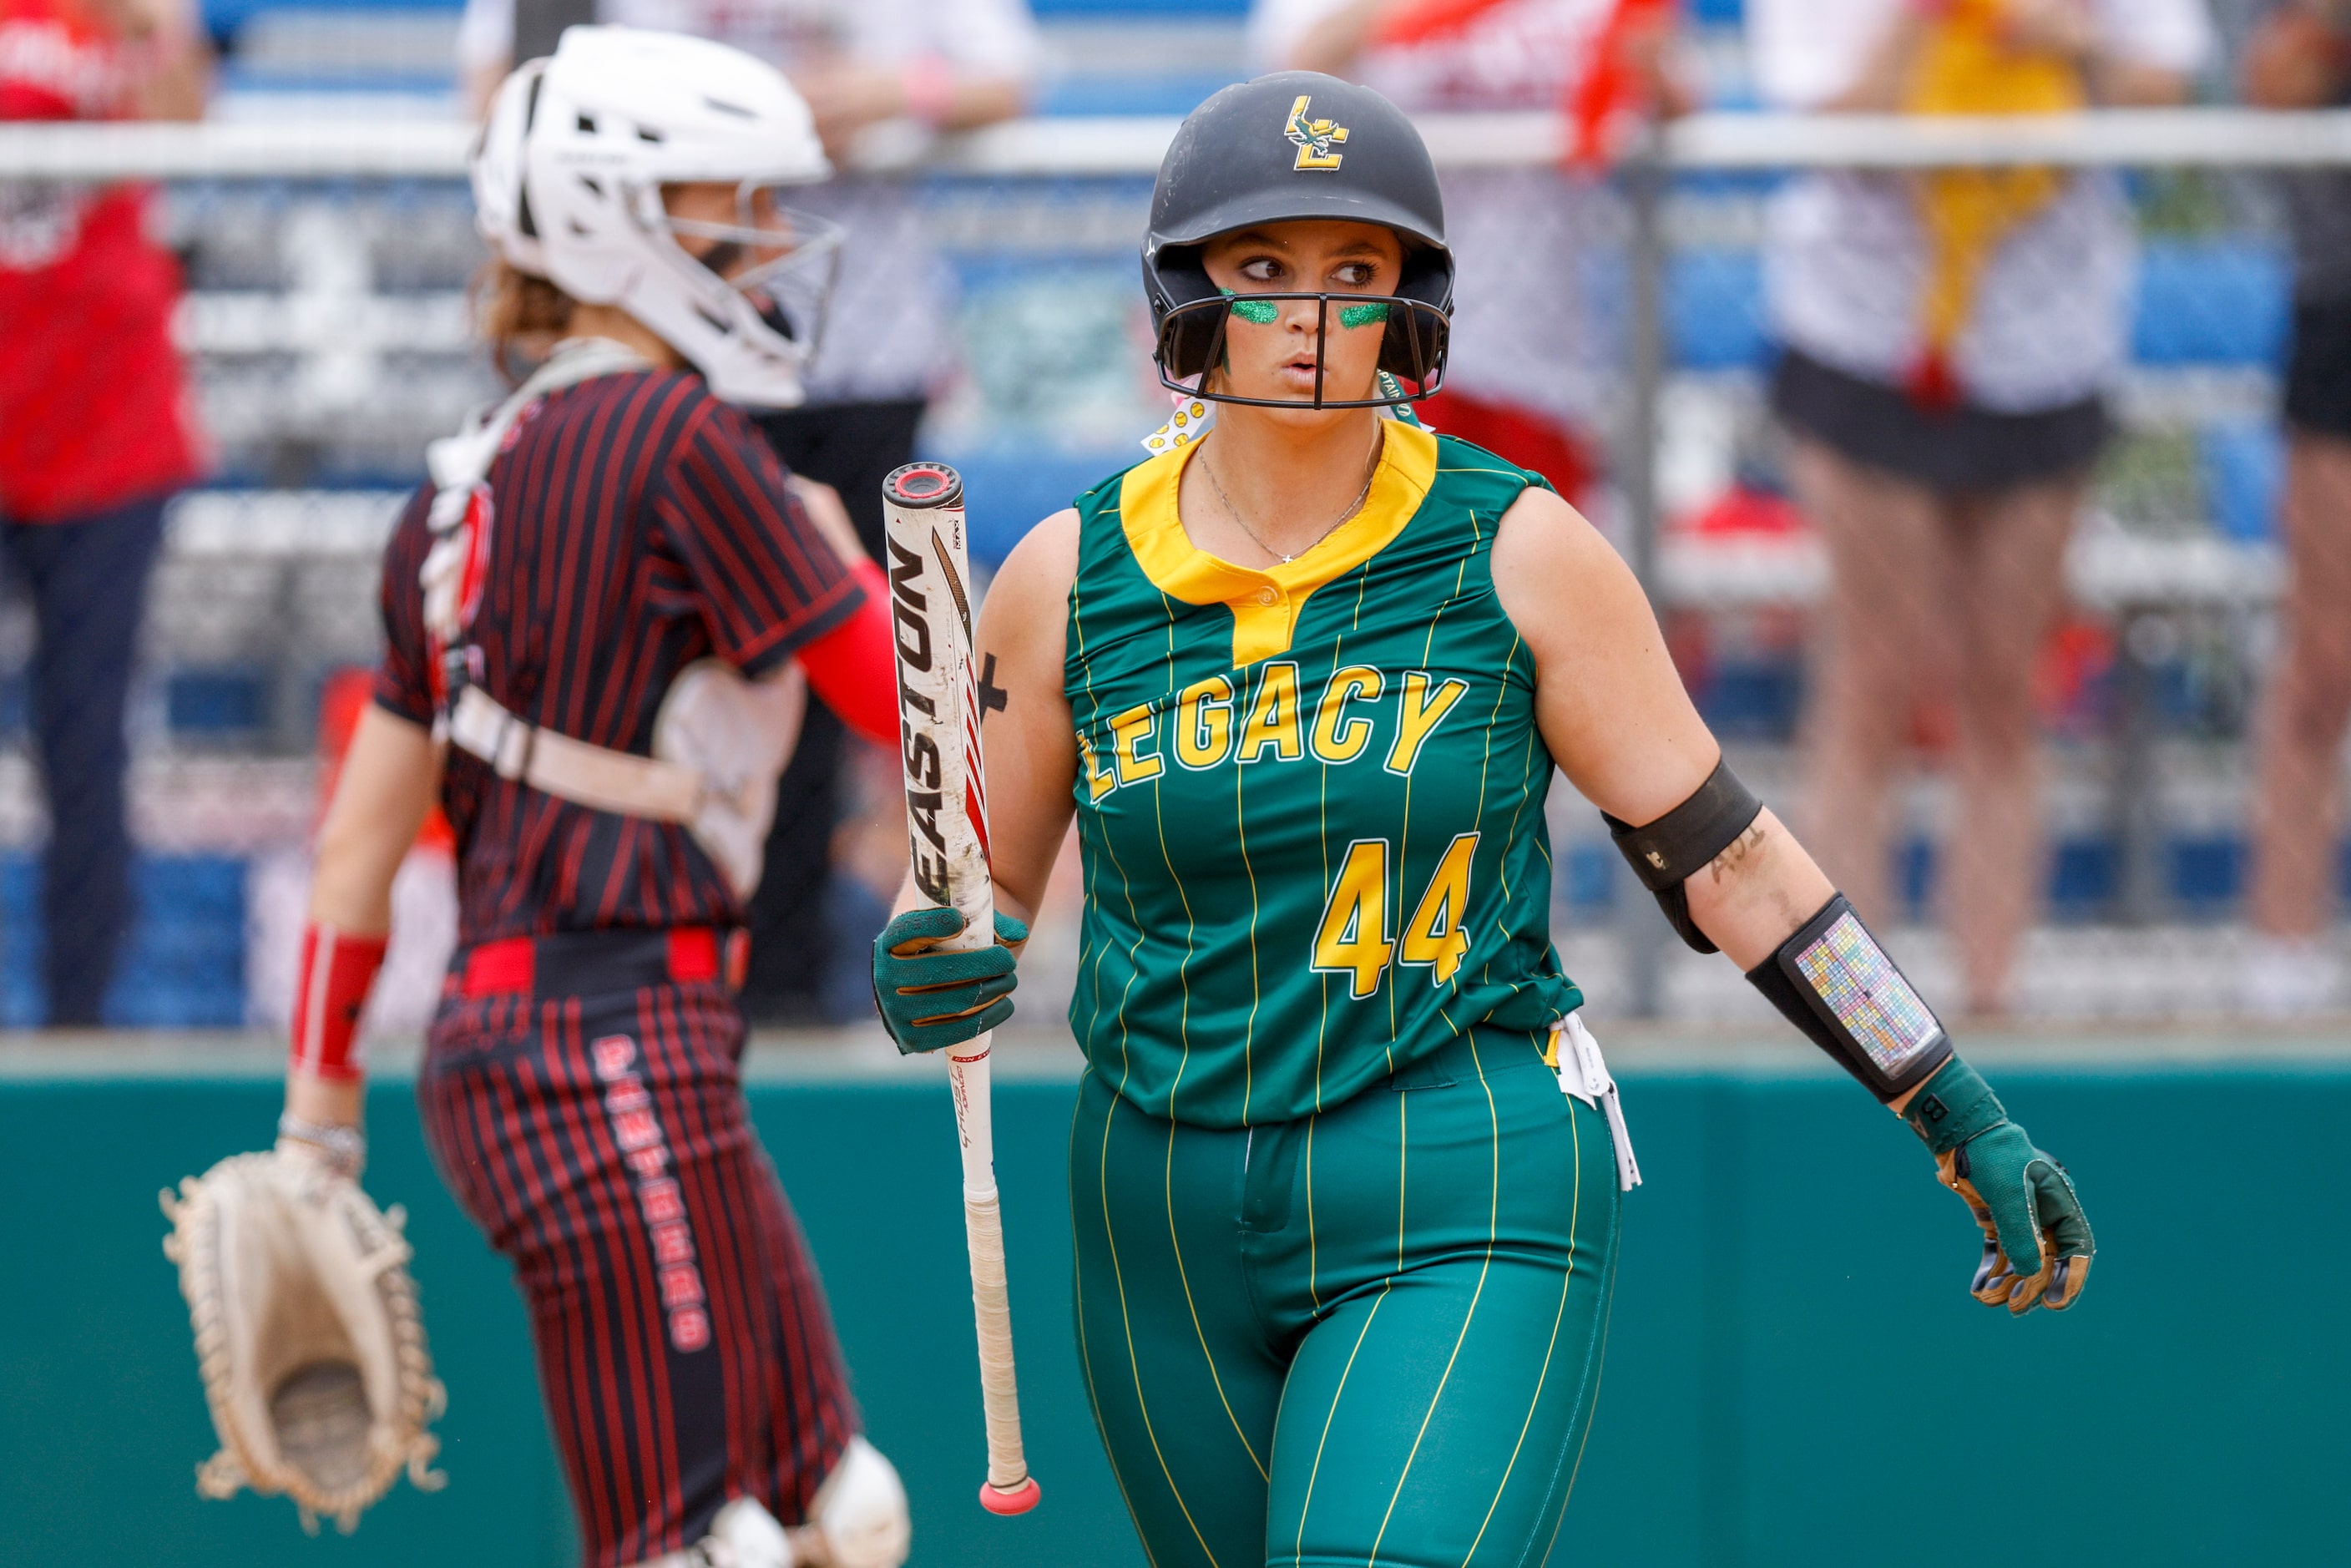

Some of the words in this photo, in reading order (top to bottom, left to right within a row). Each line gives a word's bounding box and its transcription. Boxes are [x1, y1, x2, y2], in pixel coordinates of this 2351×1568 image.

[887, 529, 952, 908] EASTON
[1076, 660, 1469, 804] LEGACY
[1309, 832, 1481, 1000] 44
